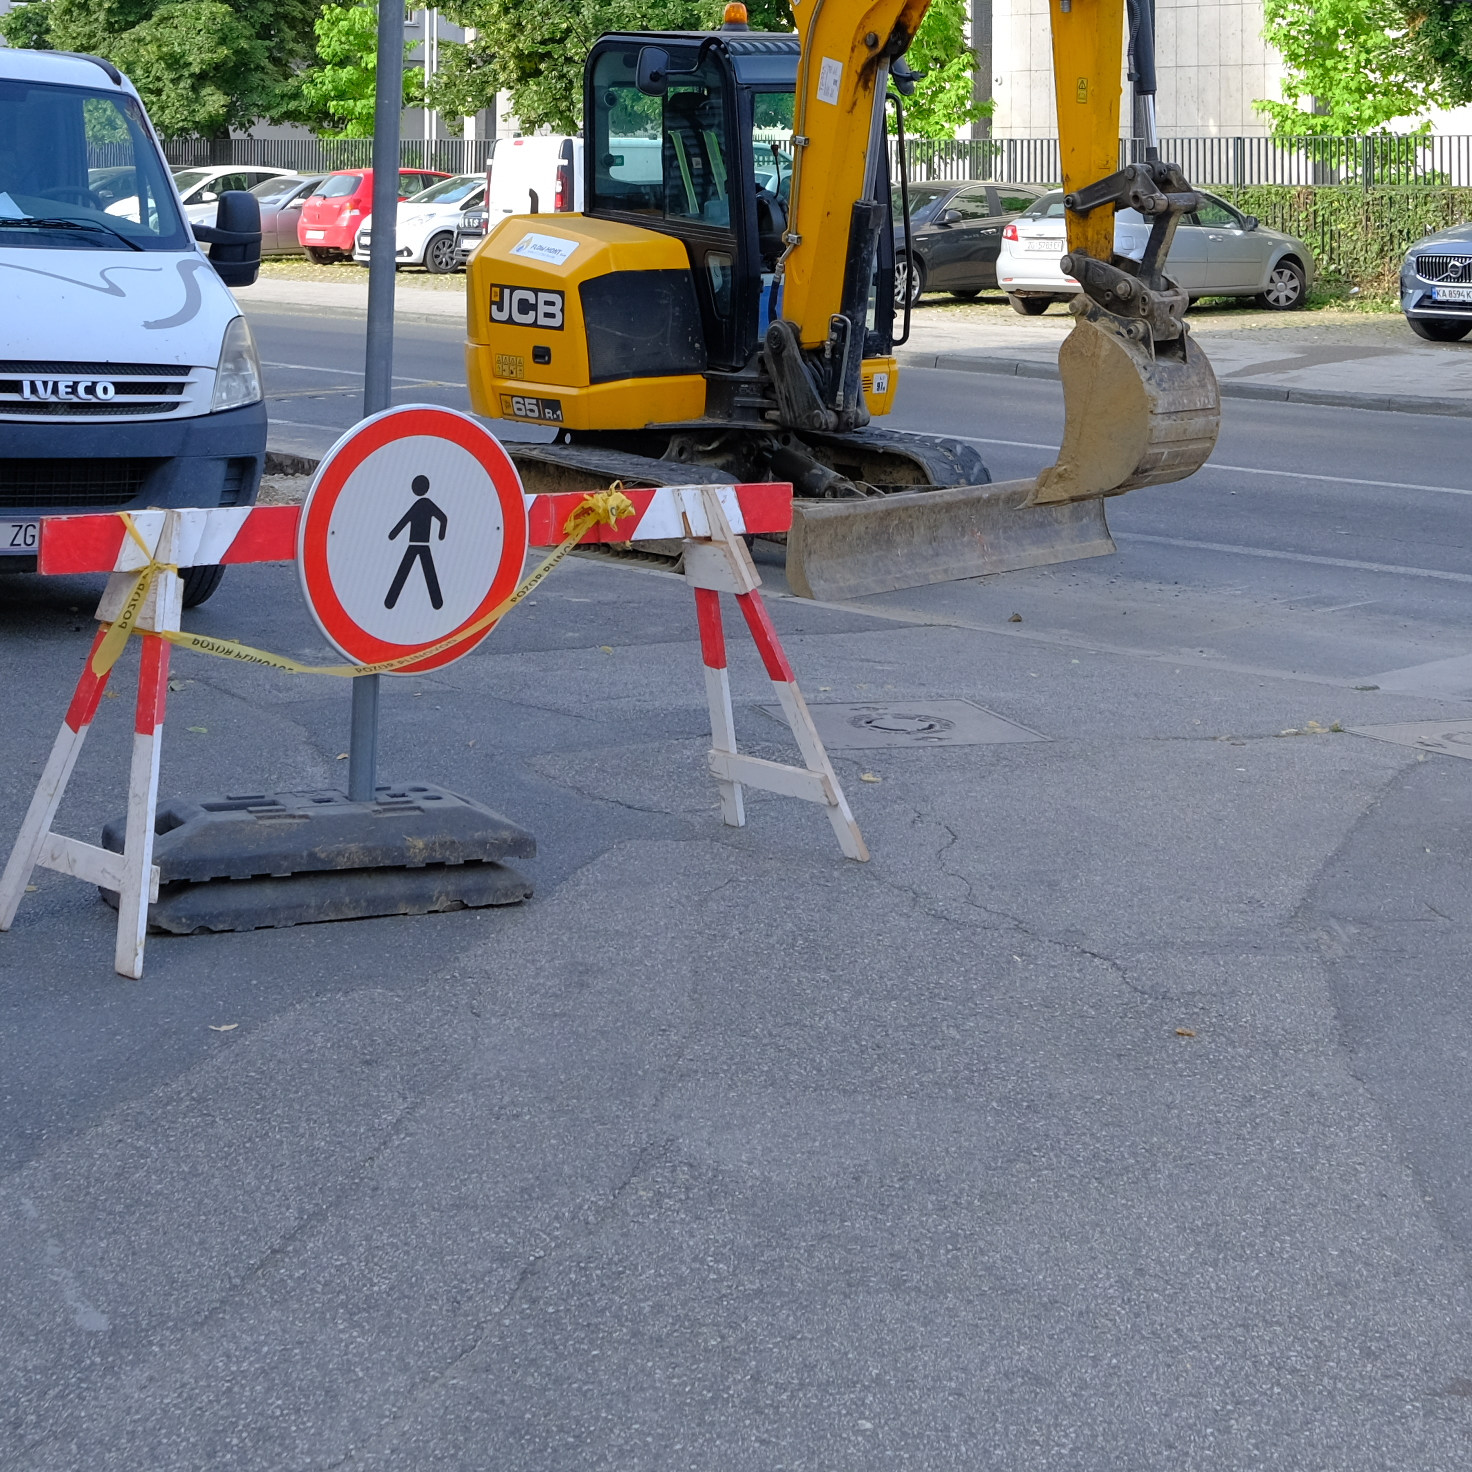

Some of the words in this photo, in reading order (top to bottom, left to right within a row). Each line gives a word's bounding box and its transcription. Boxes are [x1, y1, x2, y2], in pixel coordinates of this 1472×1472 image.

[1437, 289, 1447, 298] KA
[491, 288, 563, 327] JCB
[21, 380, 116, 401] IVECO
[512, 397, 539, 418] 65
[9, 524, 37, 548] ZG
[510, 573, 543, 603] POZOR
[354, 661, 395, 673] POZOR
